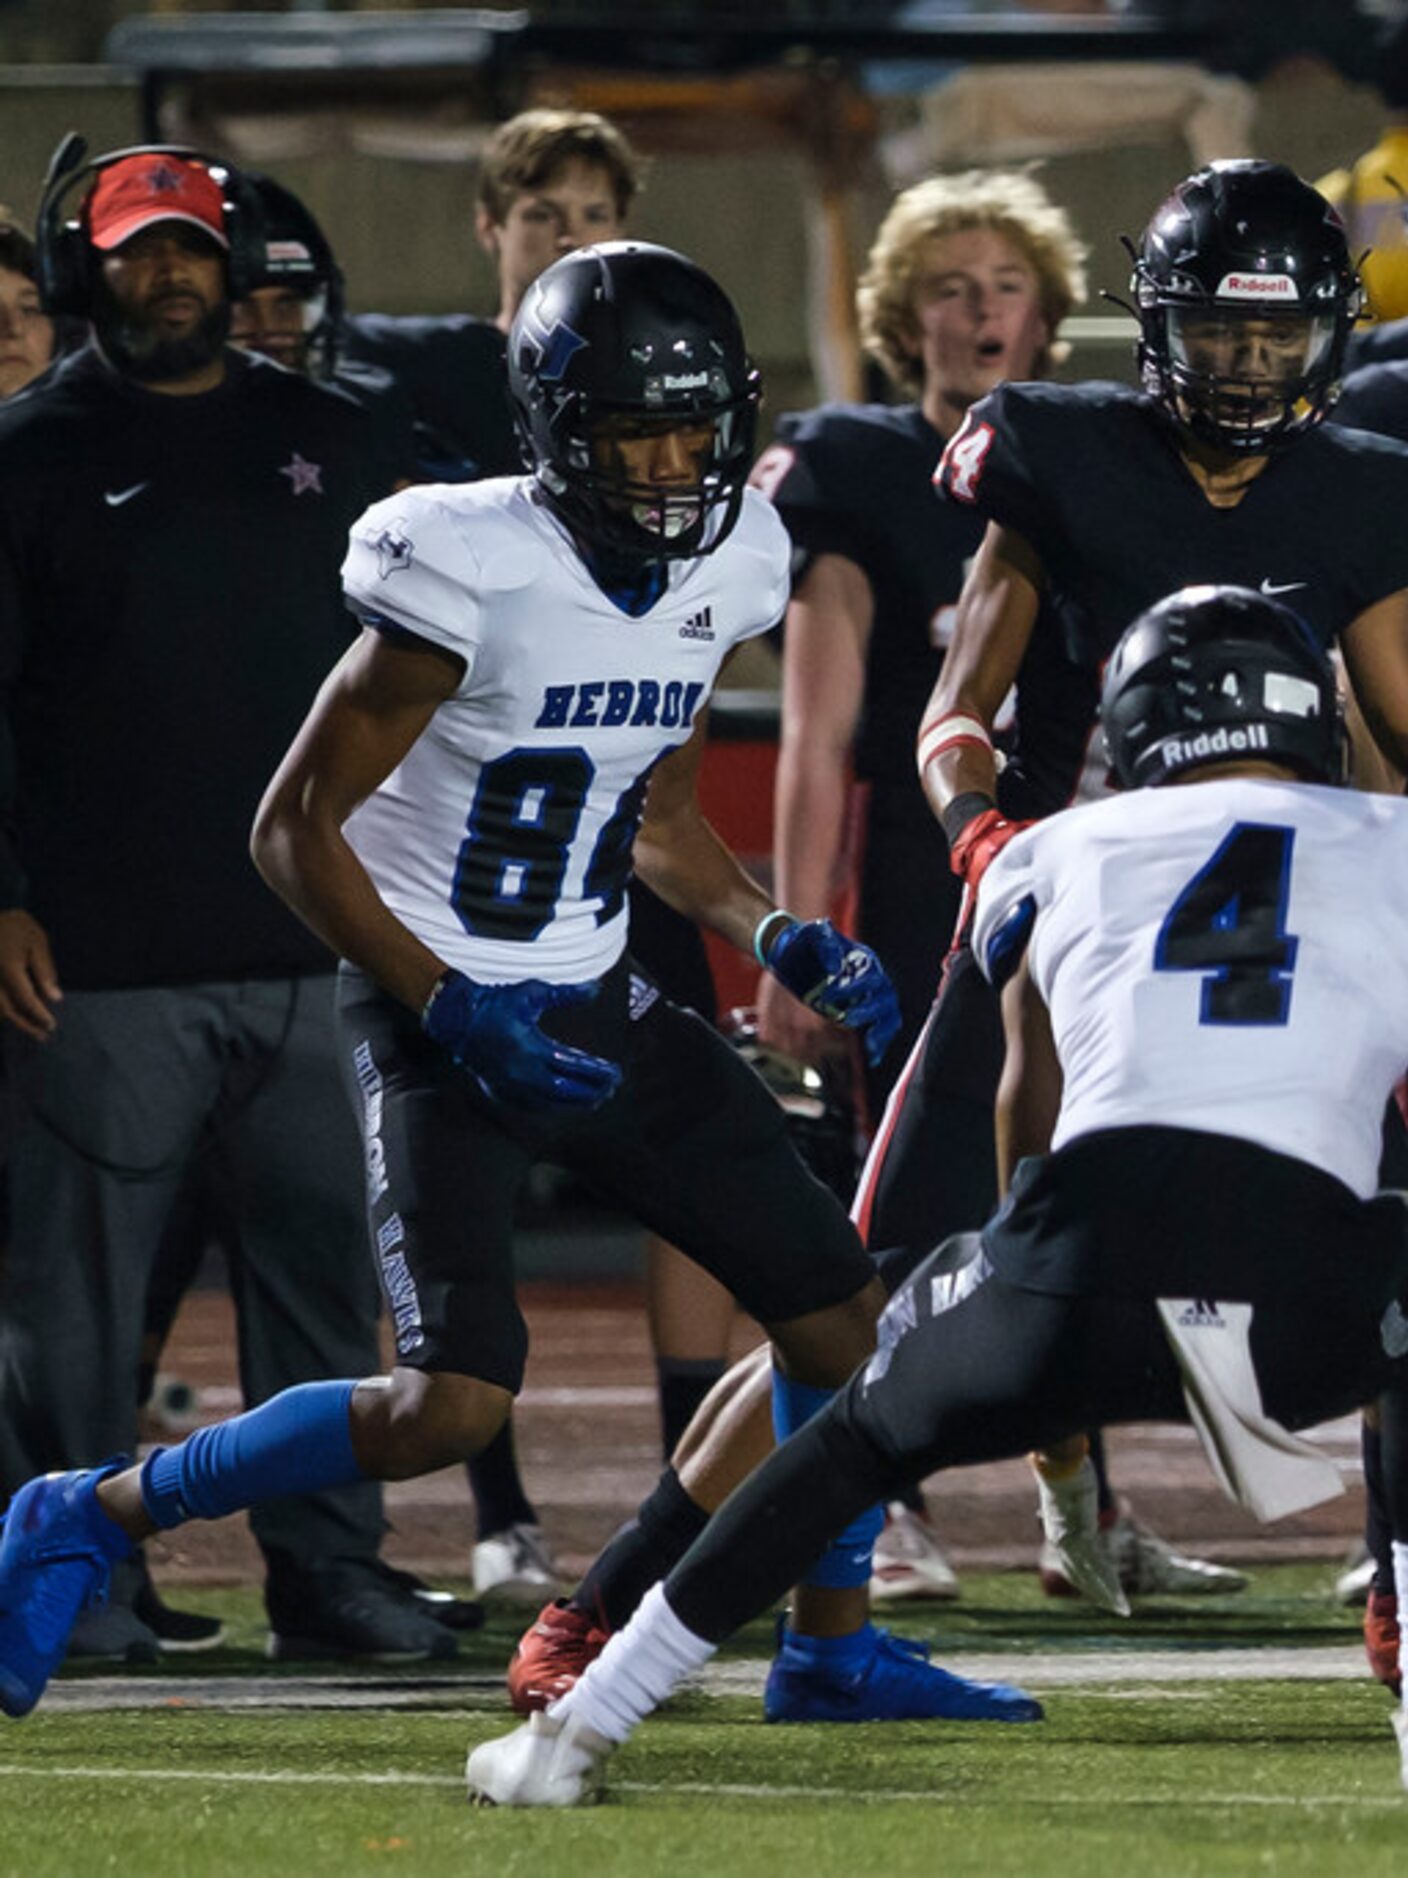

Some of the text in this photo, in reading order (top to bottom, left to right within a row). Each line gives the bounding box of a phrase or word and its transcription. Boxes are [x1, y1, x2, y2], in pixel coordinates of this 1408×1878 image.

[1221, 673, 1239, 697] 4
[1161, 723, 1269, 768] Riddell
[1151, 820, 1300, 1028] 4
